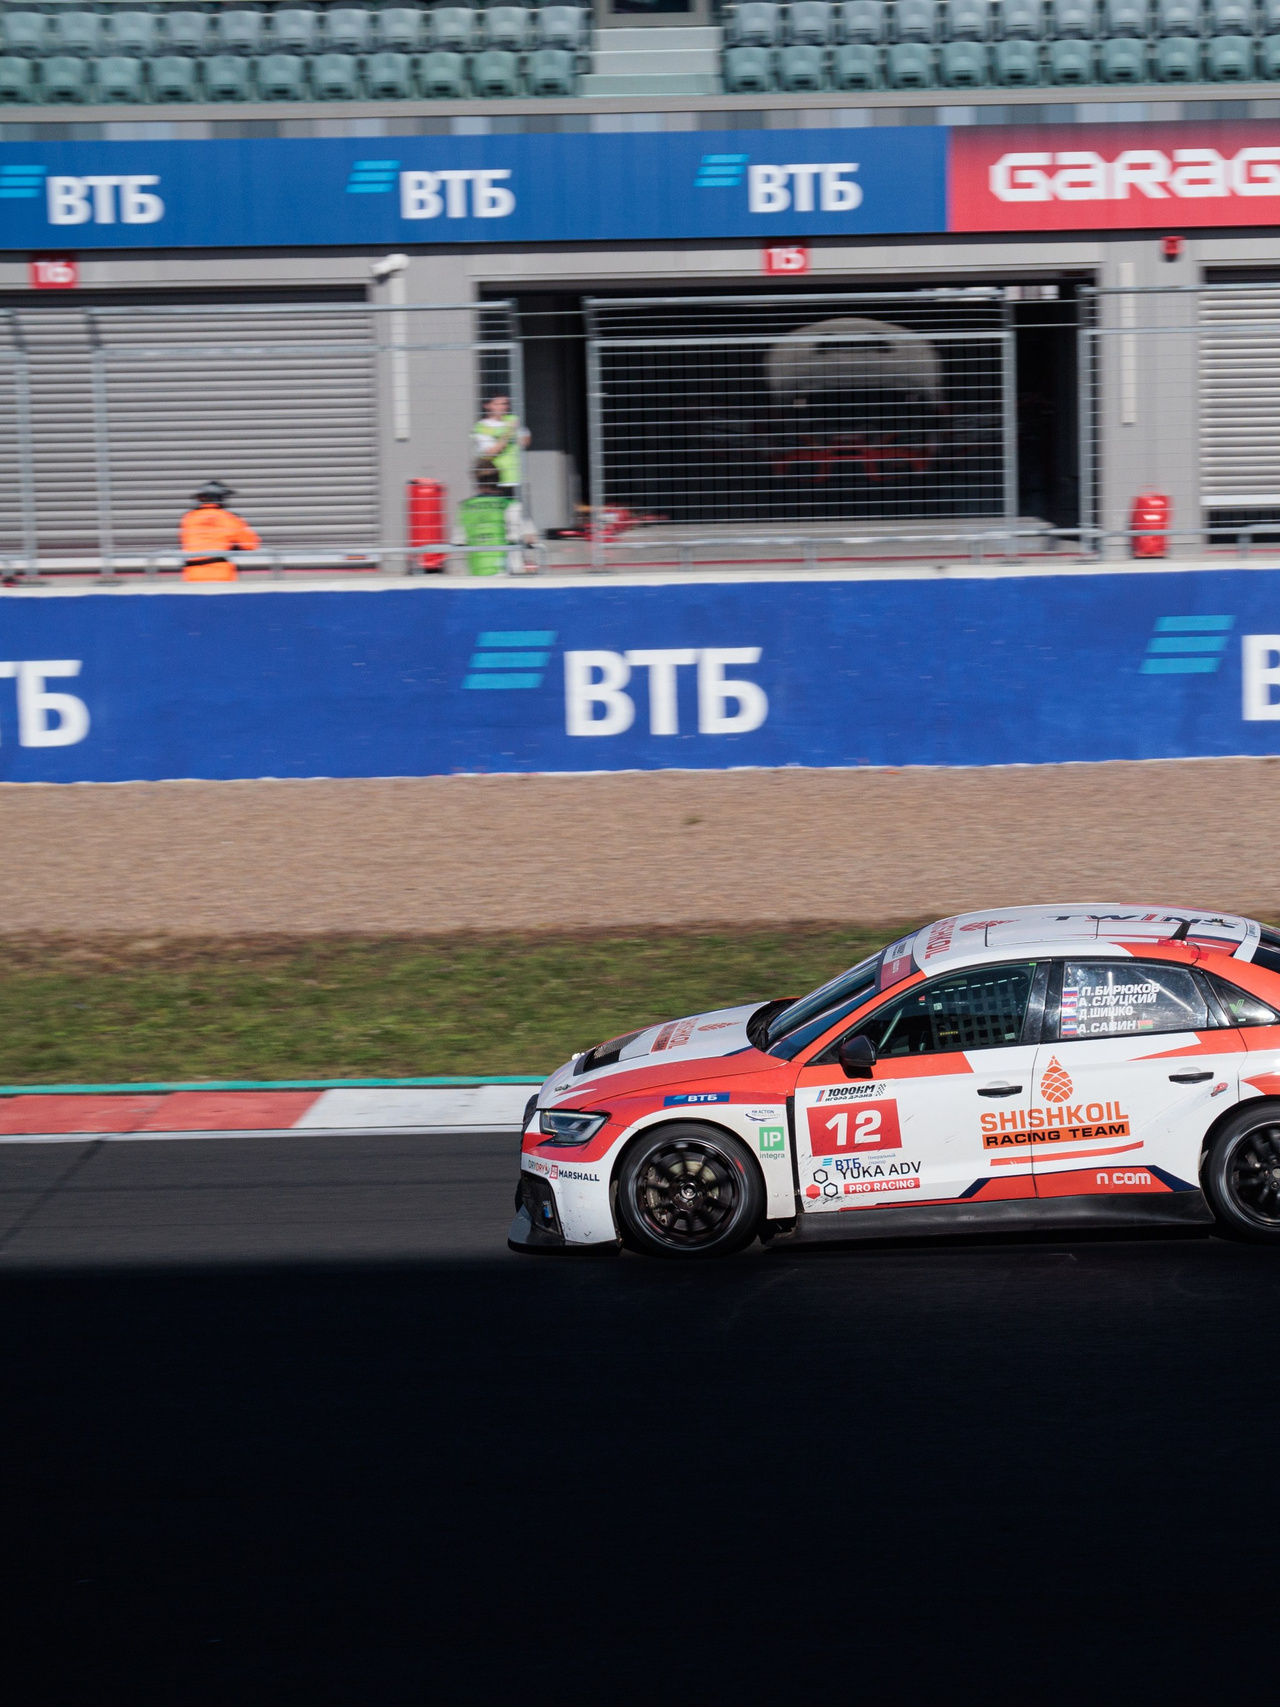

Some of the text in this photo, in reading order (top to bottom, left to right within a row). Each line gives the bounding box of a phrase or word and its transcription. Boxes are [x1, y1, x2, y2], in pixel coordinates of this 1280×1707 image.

[400, 169, 516, 219] ВТБ
[747, 163, 864, 213] ВТБ
[46, 175, 165, 225] ВТБ
[768, 247, 806, 270] 15
[35, 260, 76, 284] 16
[563, 646, 769, 737] ВТБ
[1079, 992, 1158, 1007] А.СЛУЦКИЙ
[1079, 1006, 1134, 1020] Д.ШИШКО
[687, 1093, 718, 1103] ВТБ
[825, 1109, 882, 1146] 12
[980, 1101, 1129, 1133] SHISHKOIL
[763, 1131, 782, 1147] IP
[986, 1124, 1126, 1147] RACING TEAM
[760, 1152, 785, 1160] integra
[835, 1157, 862, 1171] ВТБ
[558, 1169, 600, 1182] MARSHALL
[840, 1161, 921, 1180] YUKA ADV
[849, 1180, 915, 1193] PRO RACING
